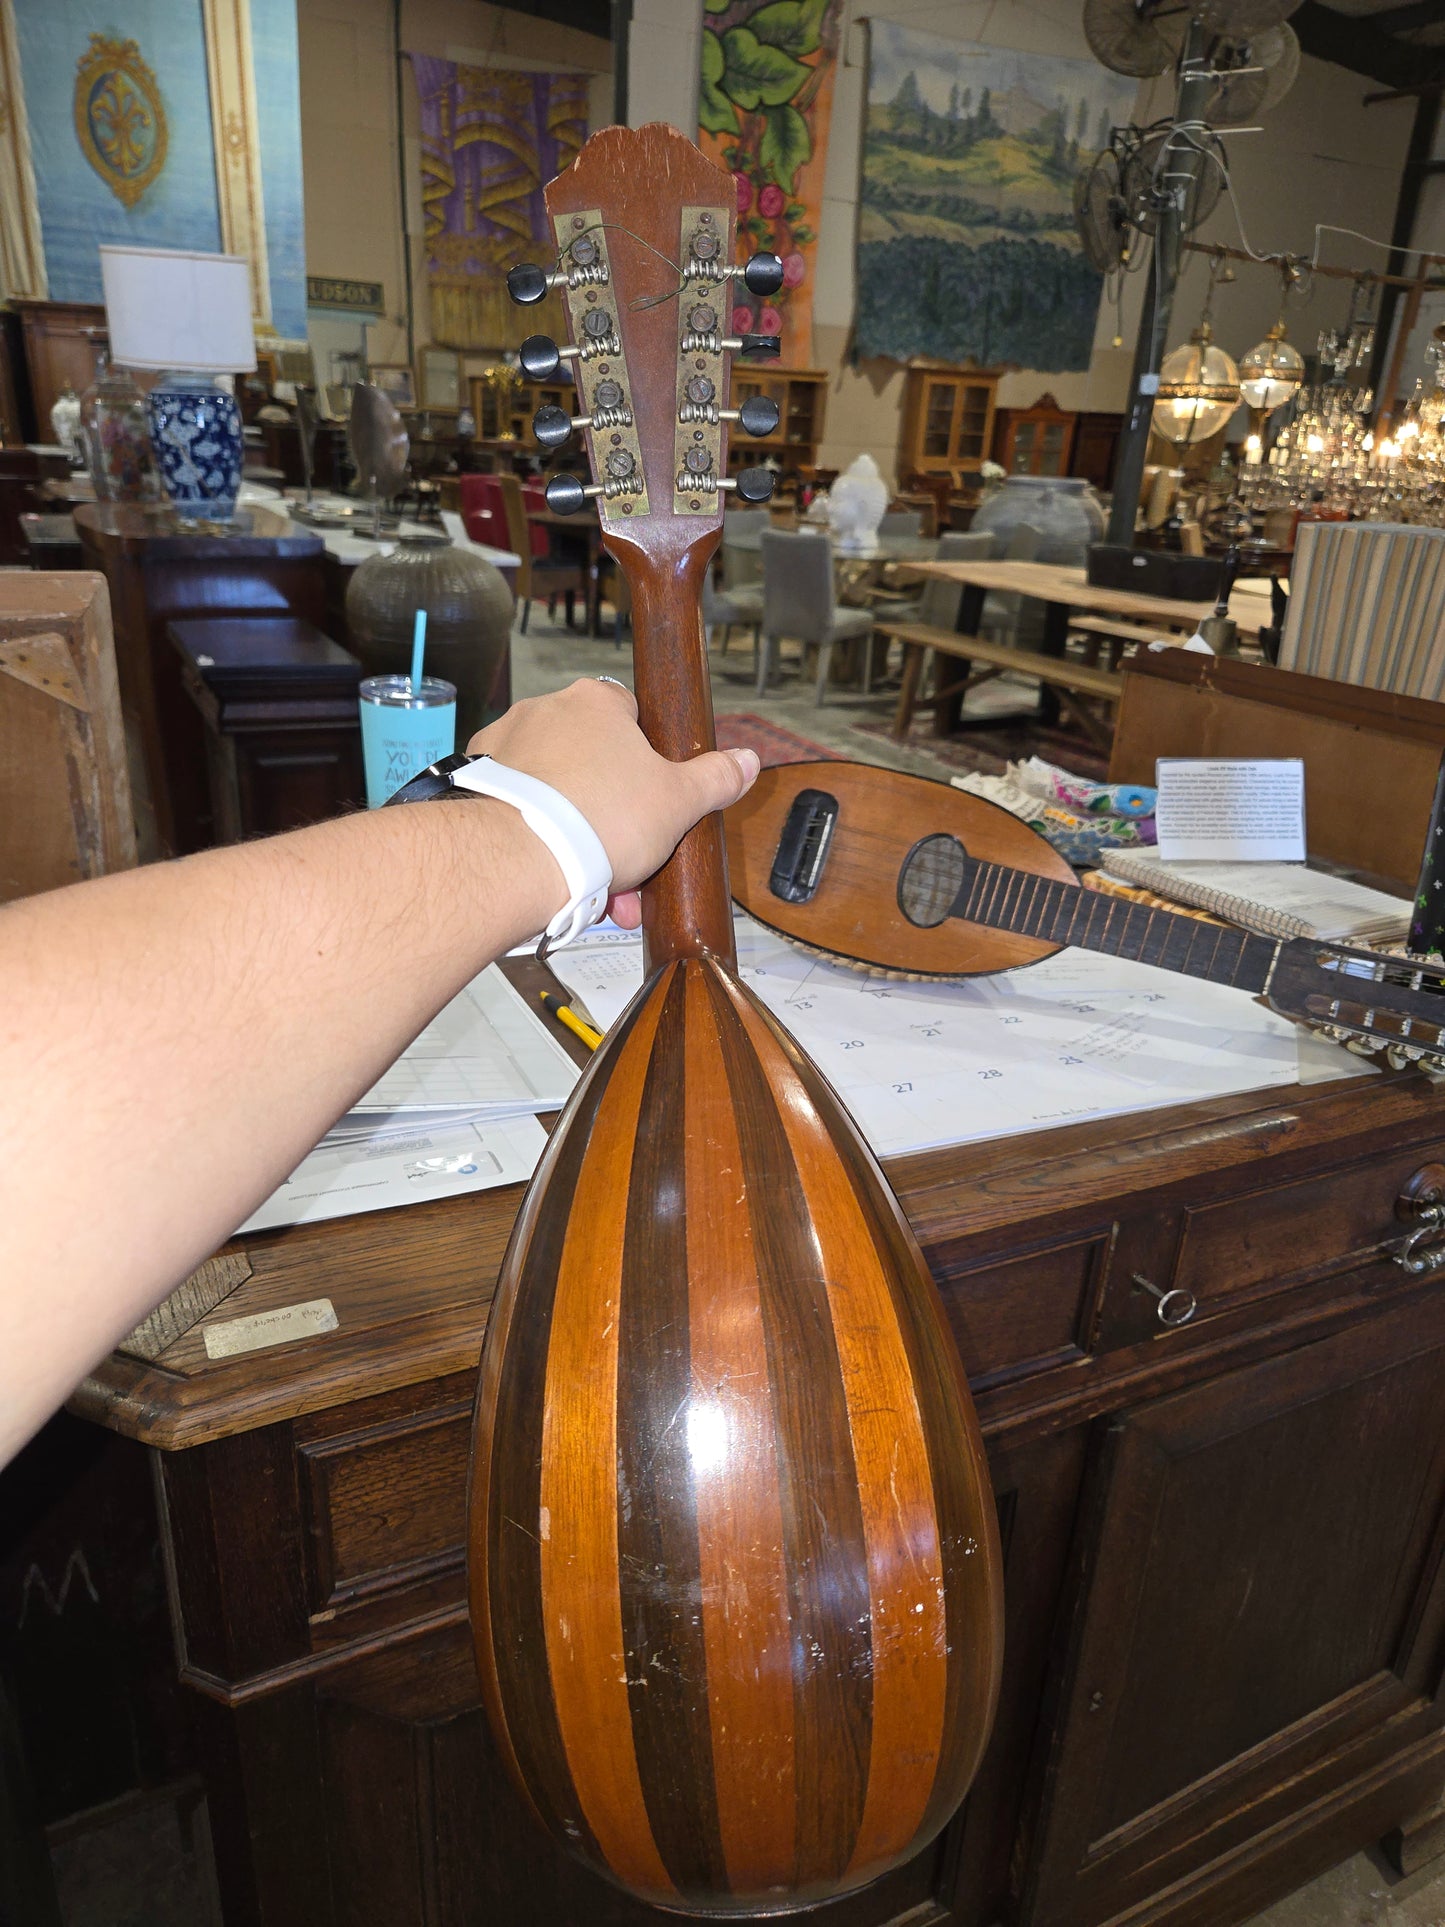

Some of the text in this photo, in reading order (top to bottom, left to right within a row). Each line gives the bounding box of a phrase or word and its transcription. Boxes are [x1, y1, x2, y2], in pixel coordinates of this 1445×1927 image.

[596, 932, 642, 943] 2025
[754, 967, 767, 976] 6
[793, 1001, 813, 1011] 13
[999, 1015, 1023, 1025] 22
[921, 1028, 942, 1037] 21
[840, 1039, 865, 1050] 20
[977, 1068, 1003, 1080] 28
[891, 1081, 913, 1094] 27
